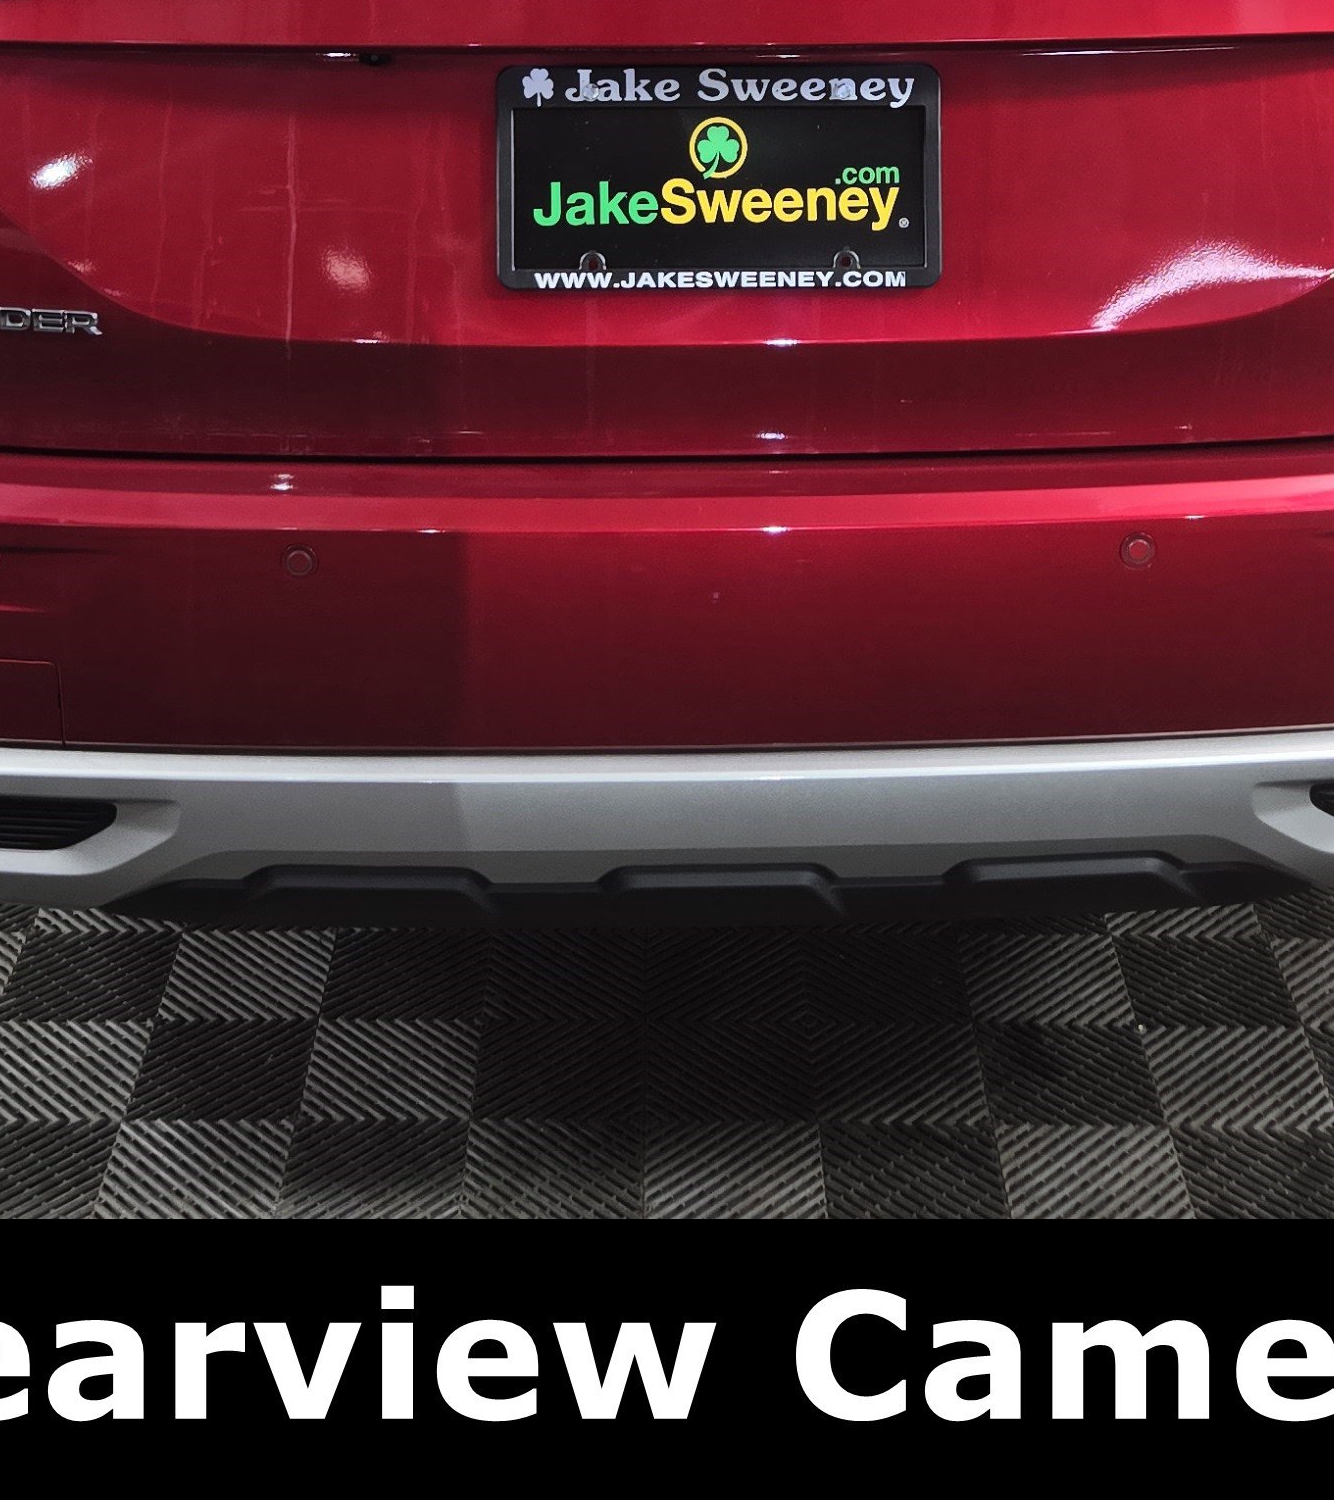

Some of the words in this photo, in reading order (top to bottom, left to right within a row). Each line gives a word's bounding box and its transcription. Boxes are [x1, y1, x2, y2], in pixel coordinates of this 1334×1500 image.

[565, 68, 681, 103] Jake
[697, 68, 915, 109] Sweeney
[835, 164, 900, 186] .com
[534, 270, 907, 290] WWW.JAKESWEENEY.COM
